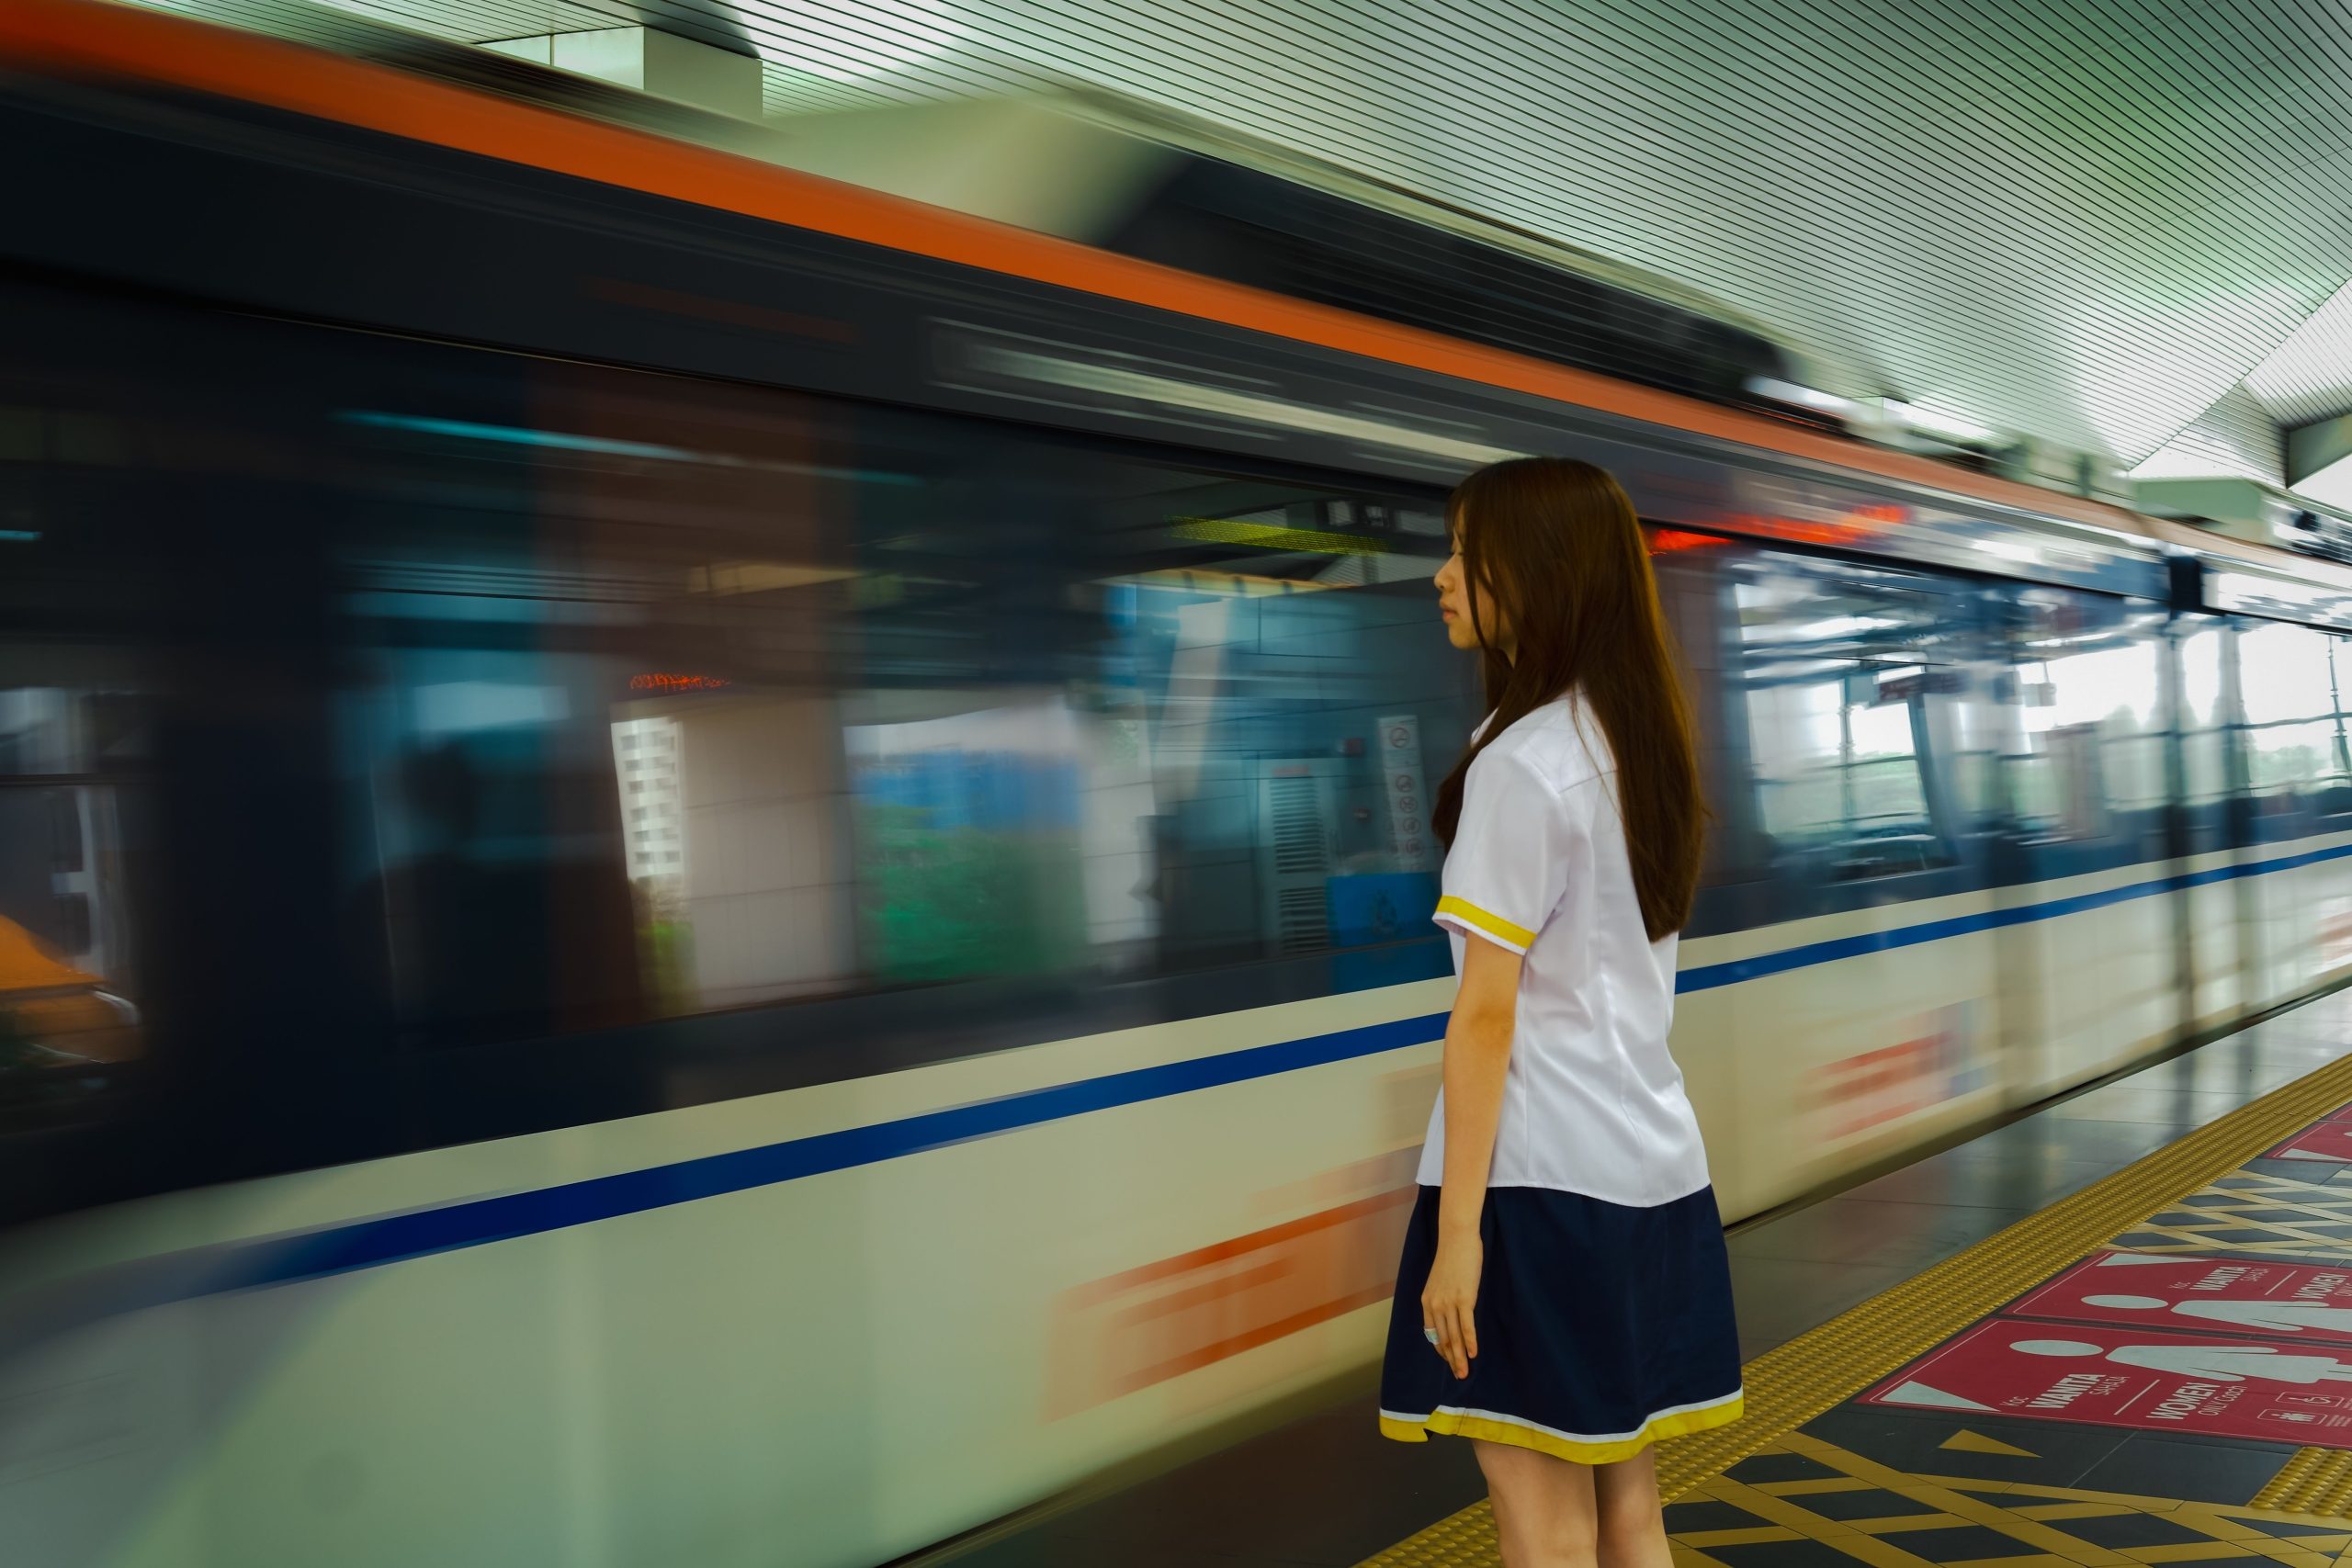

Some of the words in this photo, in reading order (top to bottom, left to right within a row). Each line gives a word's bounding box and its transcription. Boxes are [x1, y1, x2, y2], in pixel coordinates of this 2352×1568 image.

[2188, 1266, 2252, 1291] WANITA
[2290, 1272, 2349, 1299] WOMEN
[2025, 1373, 2107, 1408] WANITA
[2088, 1376, 2131, 1395] SAHAJA
[2145, 1382, 2221, 1420] WOMEN
[2198, 1400, 2228, 1416] ONLY
[2213, 1385, 2247, 1402] Coach
